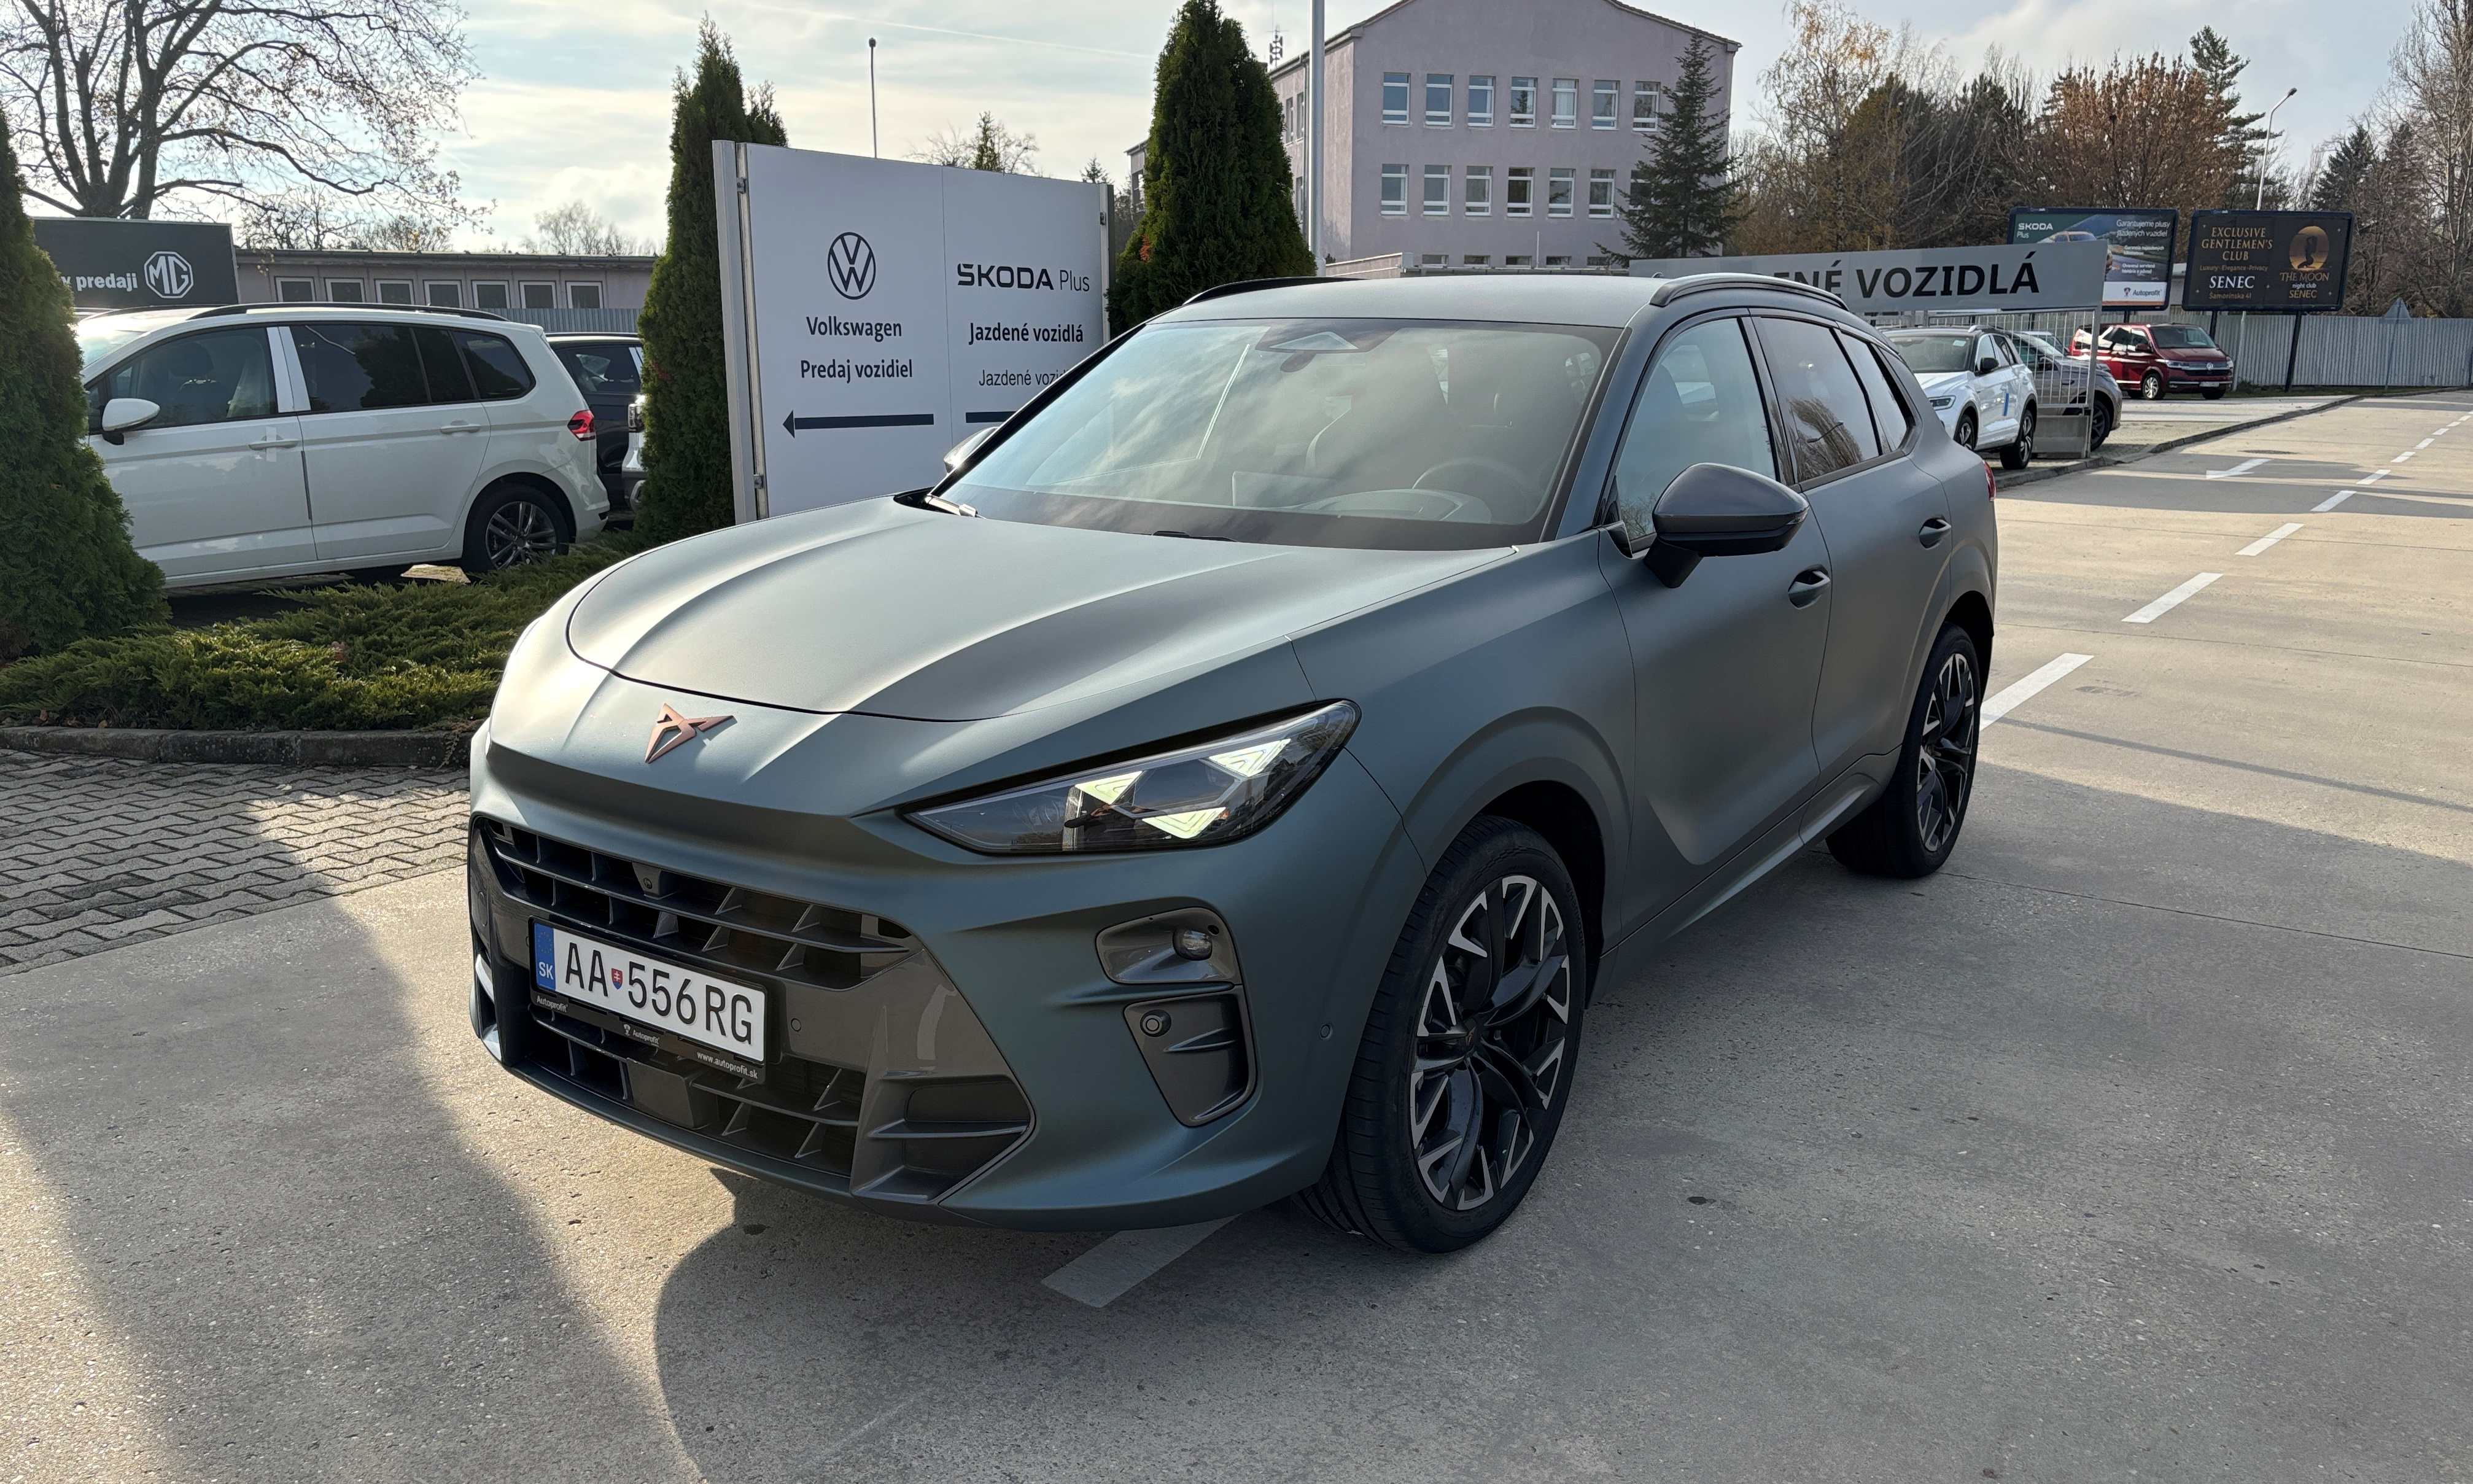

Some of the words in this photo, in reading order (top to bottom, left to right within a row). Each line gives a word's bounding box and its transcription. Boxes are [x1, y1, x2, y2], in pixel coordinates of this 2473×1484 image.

[2116, 220, 2154, 229] Garantujeme
[2154, 220, 2171, 230] plusy
[2211, 227, 2265, 238] EXCLUSIVE
[2202, 239, 2272, 249] GENTLEMEN'S
[2223, 251, 2249, 261] CLUB
[76, 273, 138, 291] predaji
[1060, 270, 1090, 292] Plus
[1855, 250, 2040, 299] VOZIDLÁ
[2209, 276, 2255, 289] SENEC
[2280, 272, 2297, 282] THE
[2299, 272, 2329, 282] MOON
[806, 315, 902, 342] Volkswagen
[969, 322, 1029, 345] Jazdené
[1033, 324, 1084, 343] vozidlá
[801, 359, 851, 384] Predaj
[855, 359, 912, 378] vozidiel
[979, 370, 1031, 386] Jazdené
[538, 961, 554, 981] SK
[565, 941, 608, 997] AA
[536, 995, 569, 1013] Autoprofit
[632, 1029, 660, 1045] Autoprofit
[696, 1051, 758, 1079] www.autoprofit.sk
